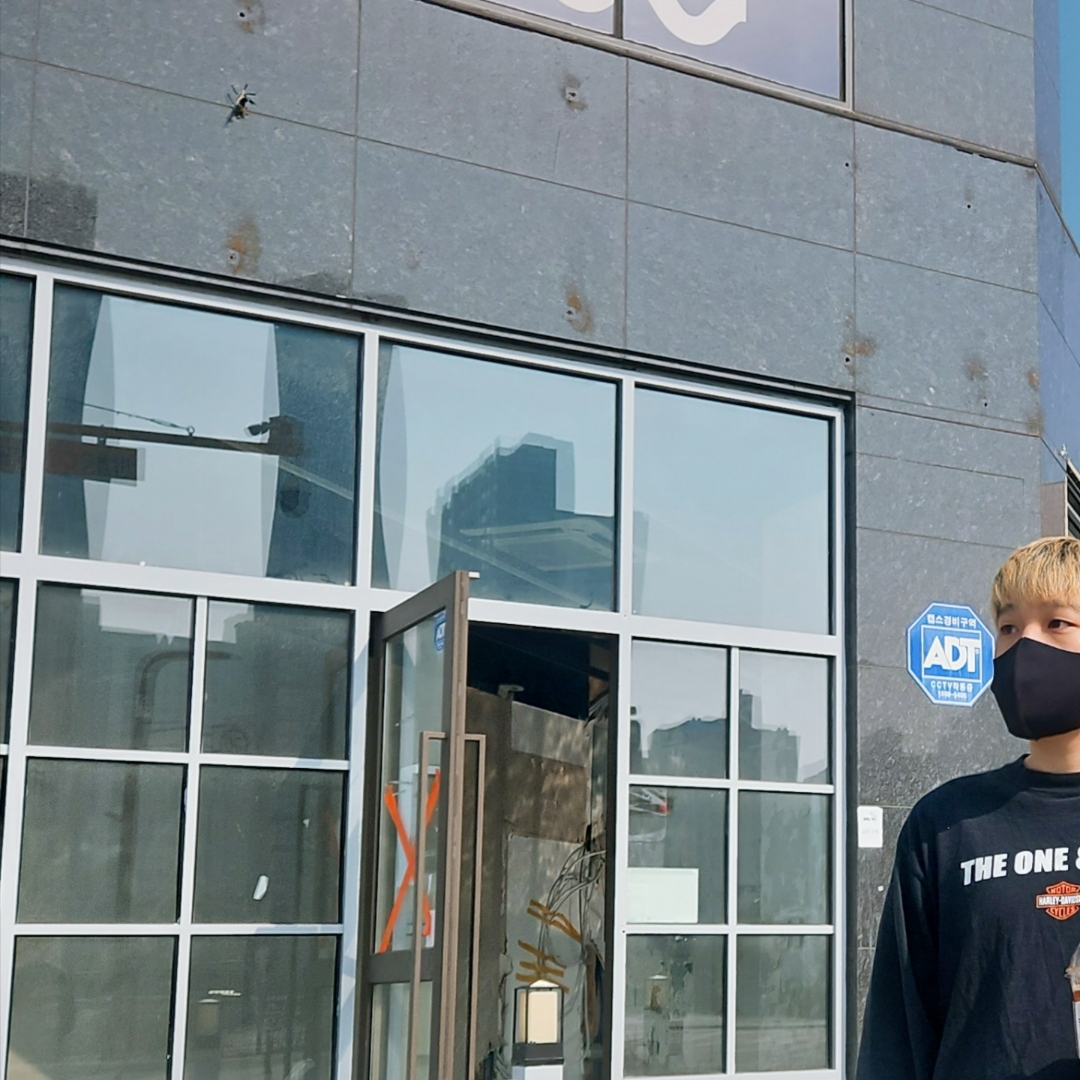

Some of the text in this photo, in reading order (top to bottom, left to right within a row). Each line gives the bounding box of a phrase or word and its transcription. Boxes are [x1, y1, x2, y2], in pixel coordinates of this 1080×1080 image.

[926, 613, 977, 629] 캡스경비구역
[923, 635, 980, 673] ADT
[961, 854, 1007, 886] THE
[1014, 847, 1069, 875] ONE
